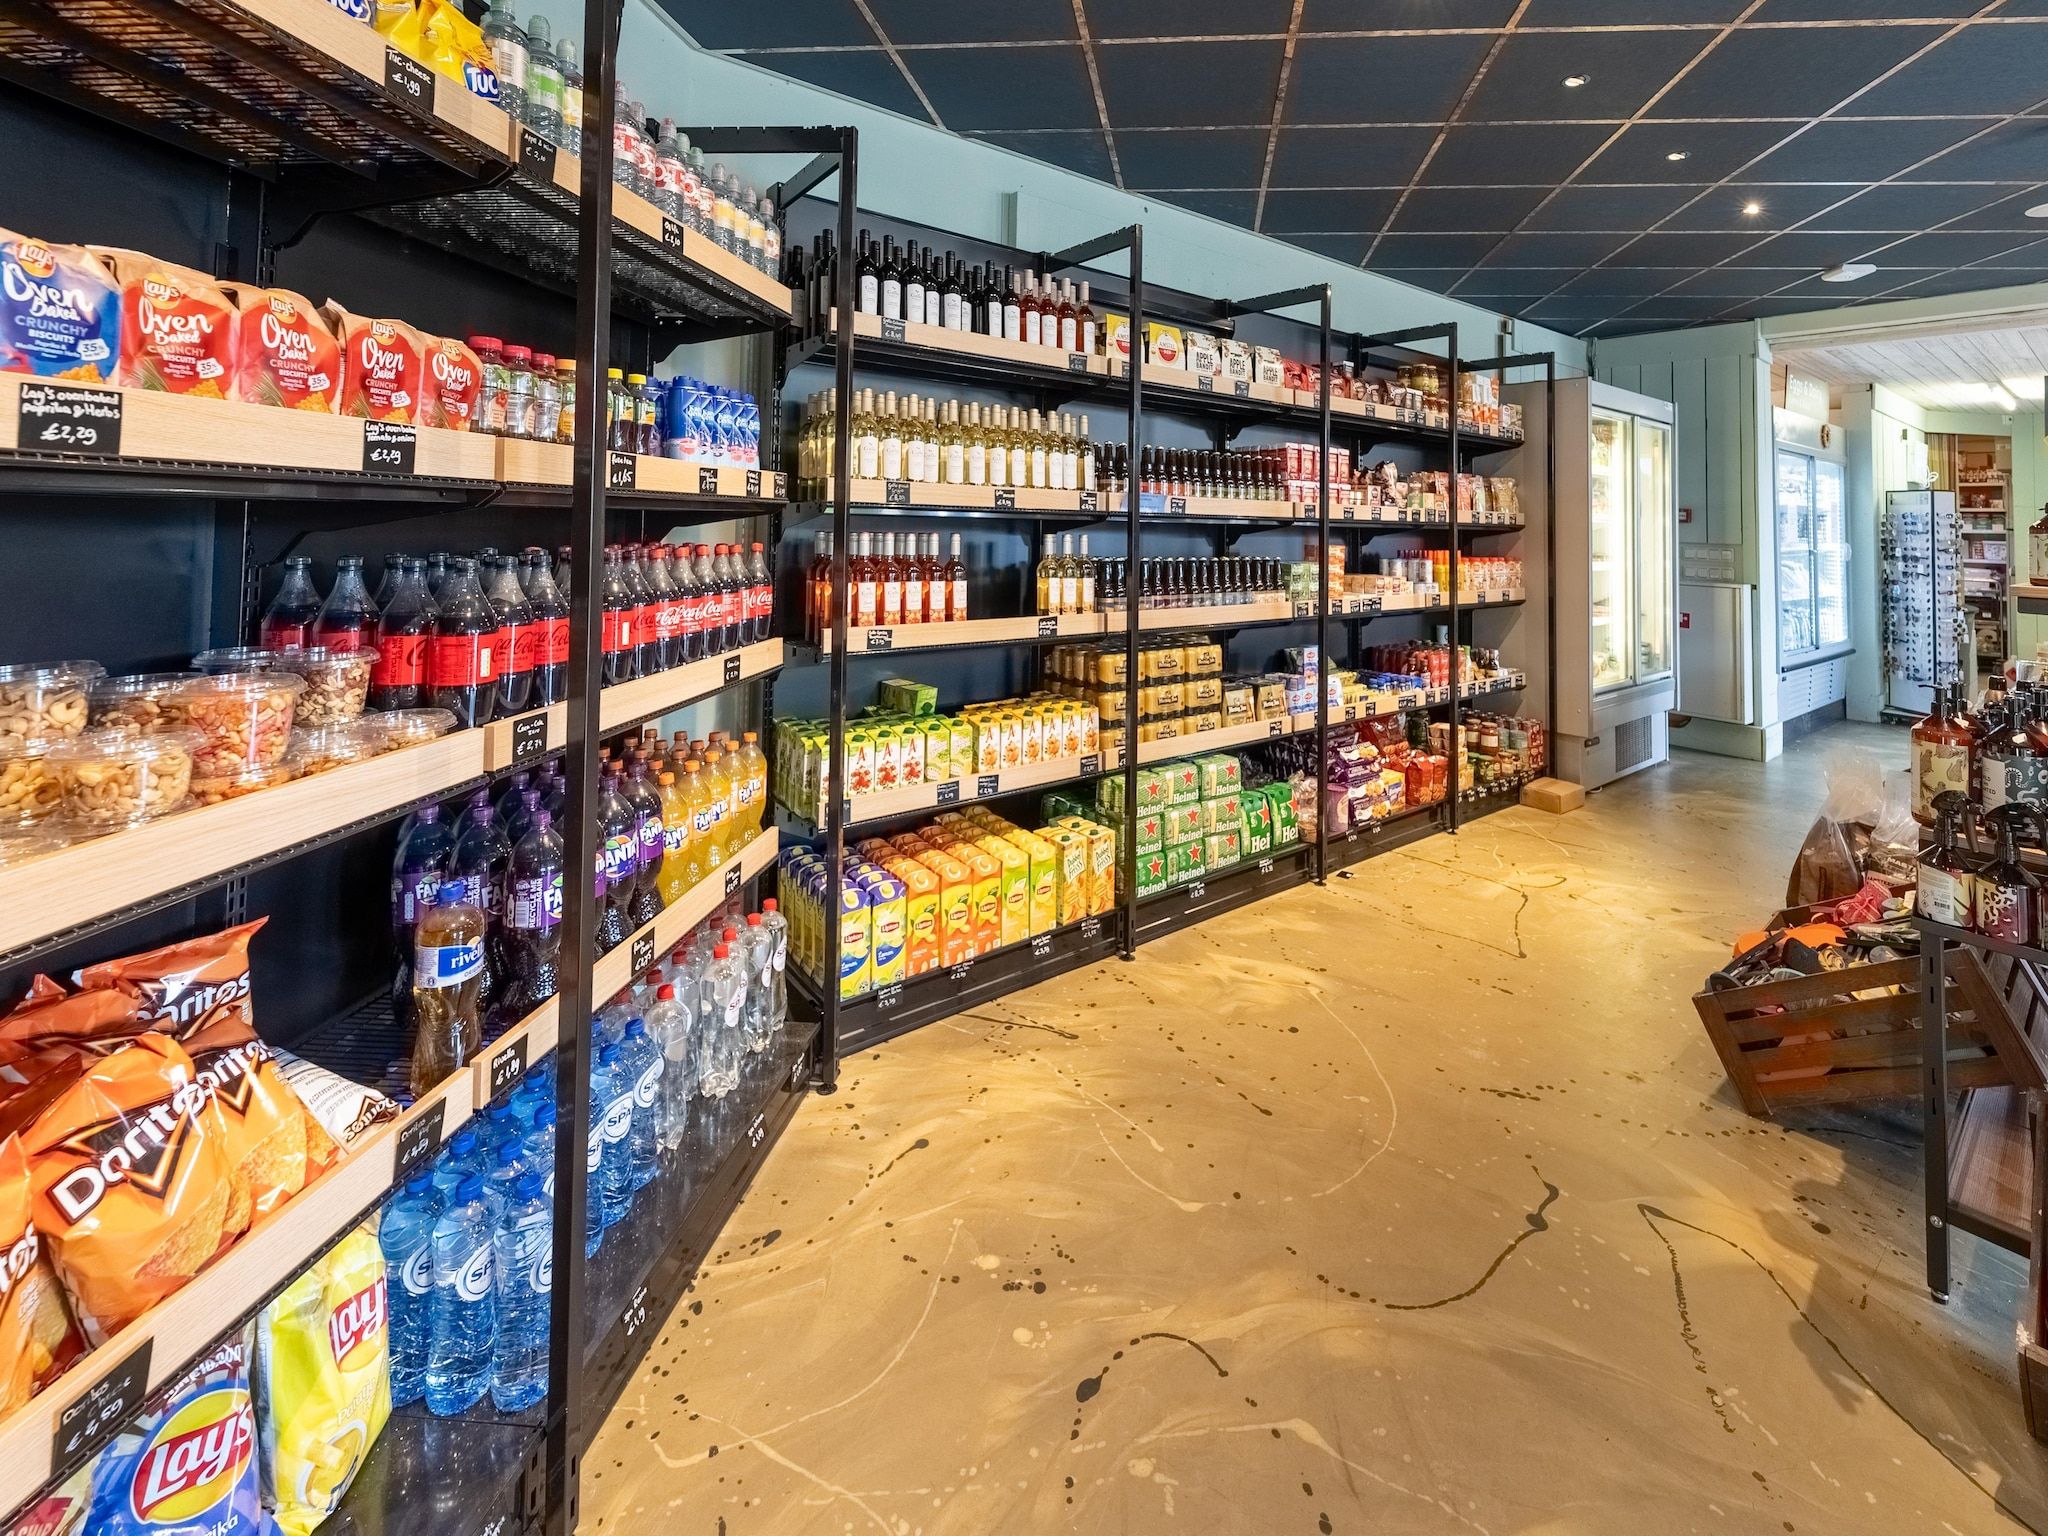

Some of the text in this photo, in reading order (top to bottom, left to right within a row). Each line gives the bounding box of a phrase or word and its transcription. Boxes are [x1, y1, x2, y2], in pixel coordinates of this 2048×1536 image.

[386, 48, 432, 85] Tuc-cheese
[391, 72, 421, 98] €1,99
[467, 66, 499, 95] TUC
[18, 244, 55, 269] Lay's
[1, 261, 95, 312] Oven
[143, 278, 180, 301] Lay's
[29, 296, 81, 322] Baked
[270, 296, 294, 315] Lay's
[138, 295, 213, 336] Oven
[14, 315, 89, 337] CRUNCHY
[261, 313, 316, 353] Oven
[372, 320, 395, 338] Lay's
[28, 329, 75, 344] BISCUITS
[154, 329, 201, 345] Baked
[147, 345, 206, 357] CRUNCHY
[162, 353, 197, 365] BISCUITS
[278, 346, 309, 361] Baked
[361, 336, 405, 372] Oven
[1196, 351, 1213, 365] APPLE
[270, 359, 316, 373] CRUNCHY
[372, 365, 396, 380] Baked
[431, 352, 472, 386] Oven
[1196, 361, 1213, 371] BANDIT
[1229, 358, 1246, 372] APPLE
[1229, 367, 1246, 377] BANDIT
[1263, 365, 1278, 376] APPLE
[279, 370, 309, 380] BISCUITS
[1263, 373, 1278, 382] BANDIT
[365, 378, 398, 391] CRUNCHY
[21, 384, 56, 406] Lay's
[84, 403, 120, 419] Herbs
[40, 422, 97, 446] €2,29
[369, 448, 402, 465] €2,29
[528, 893, 536, 929] RECYCLE
[881, 922, 900, 933] Lipton
[915, 920, 933, 930] Lipton
[141, 1402, 254, 1510] Lay's
